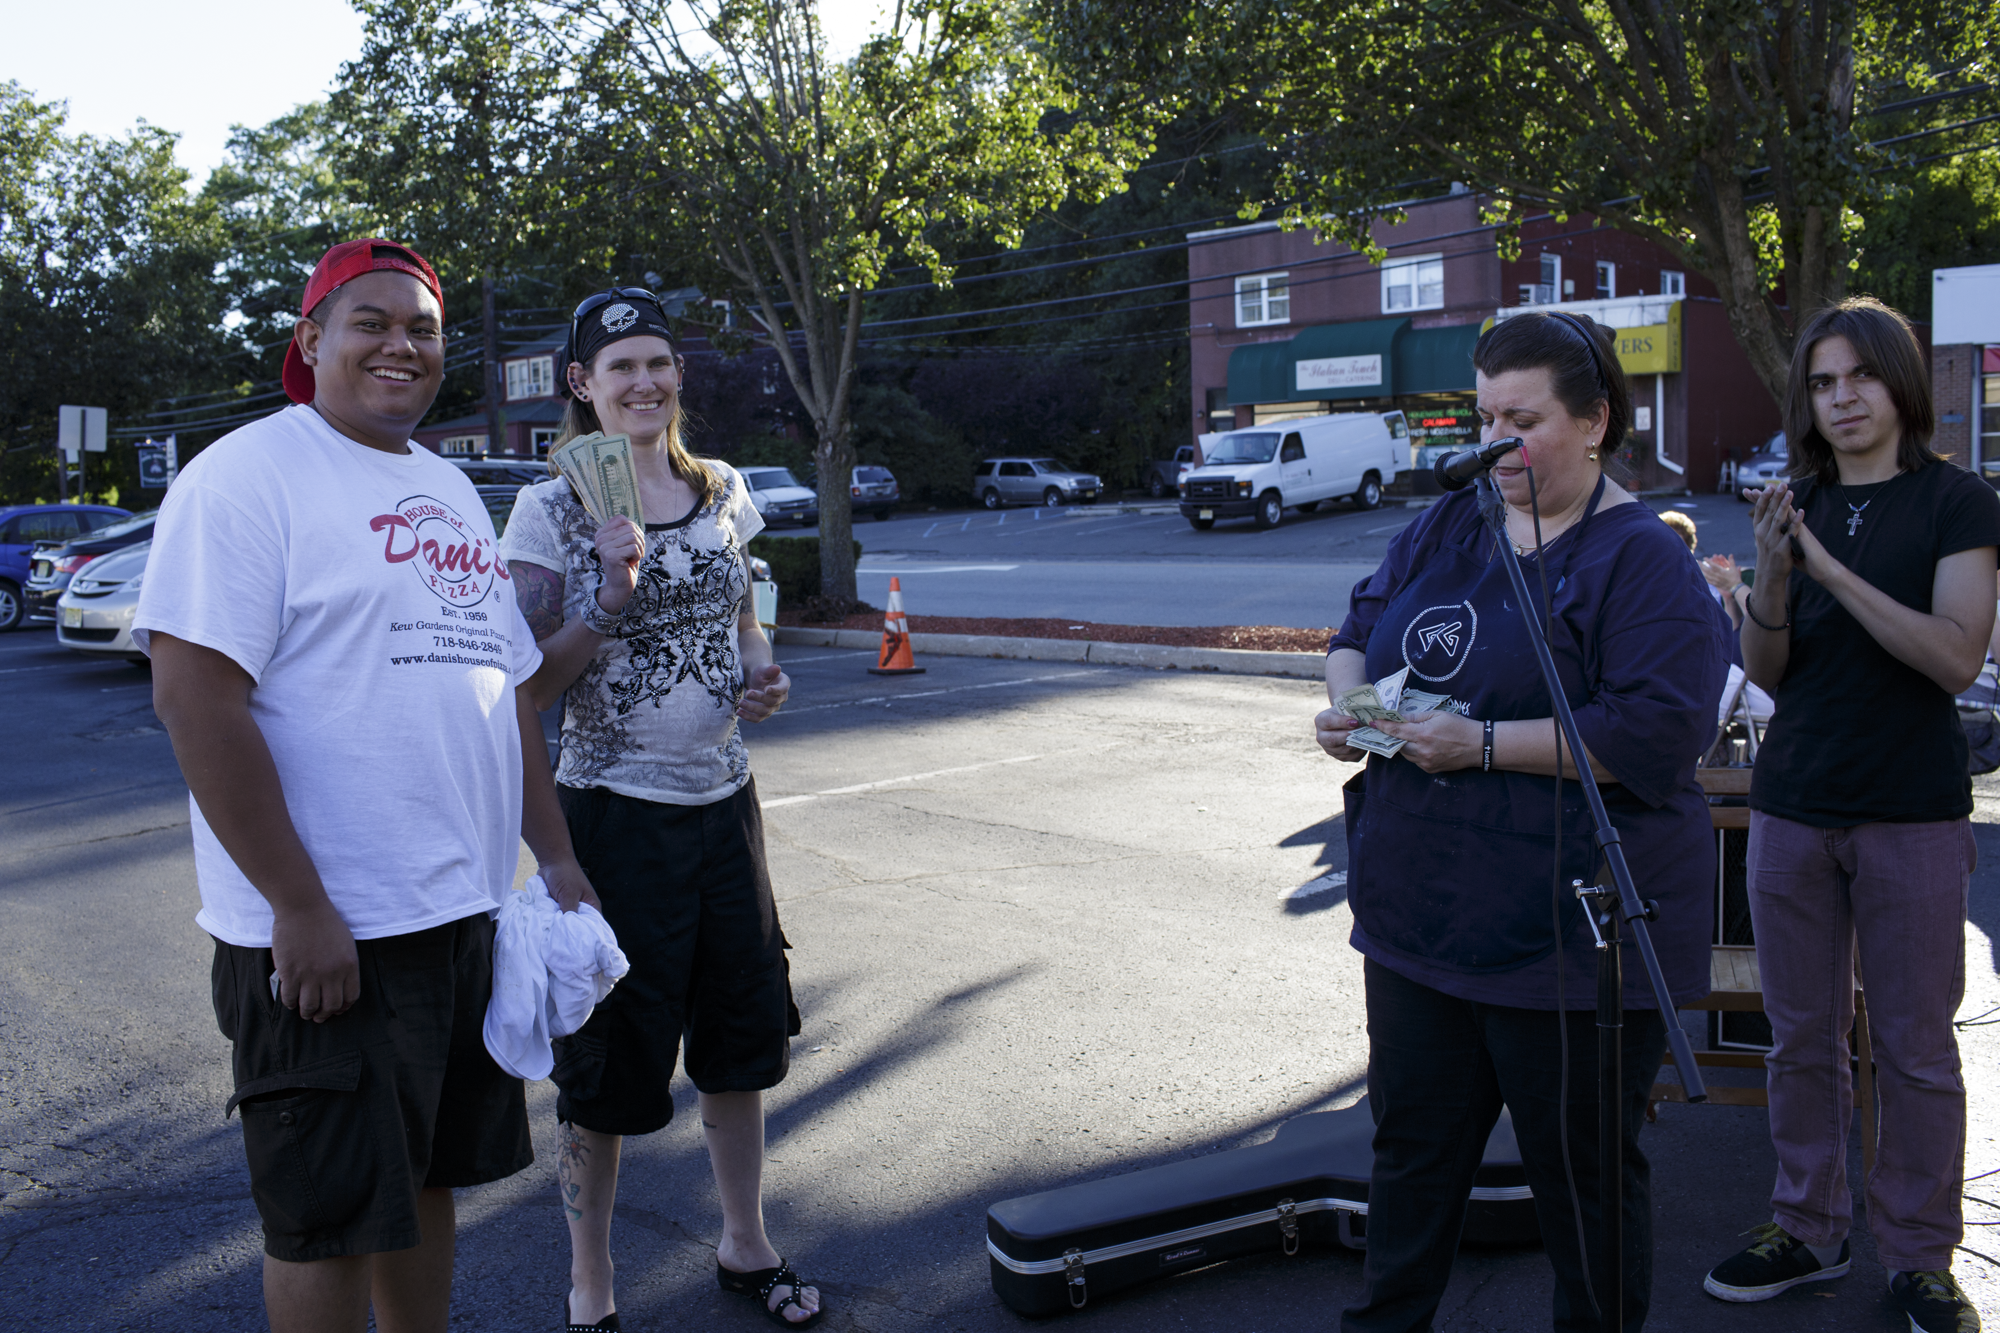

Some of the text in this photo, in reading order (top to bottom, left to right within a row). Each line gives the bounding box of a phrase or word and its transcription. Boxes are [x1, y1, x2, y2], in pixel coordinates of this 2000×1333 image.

[404, 505, 464, 529] HOUSE of
[429, 575, 481, 599] PIZZA
[463, 612, 488, 621] 1959
[390, 622, 414, 632] Kew
[416, 621, 454, 632] Gardens
[455, 625, 489, 637] Original
[433, 636, 502, 655] 718-846-2849
